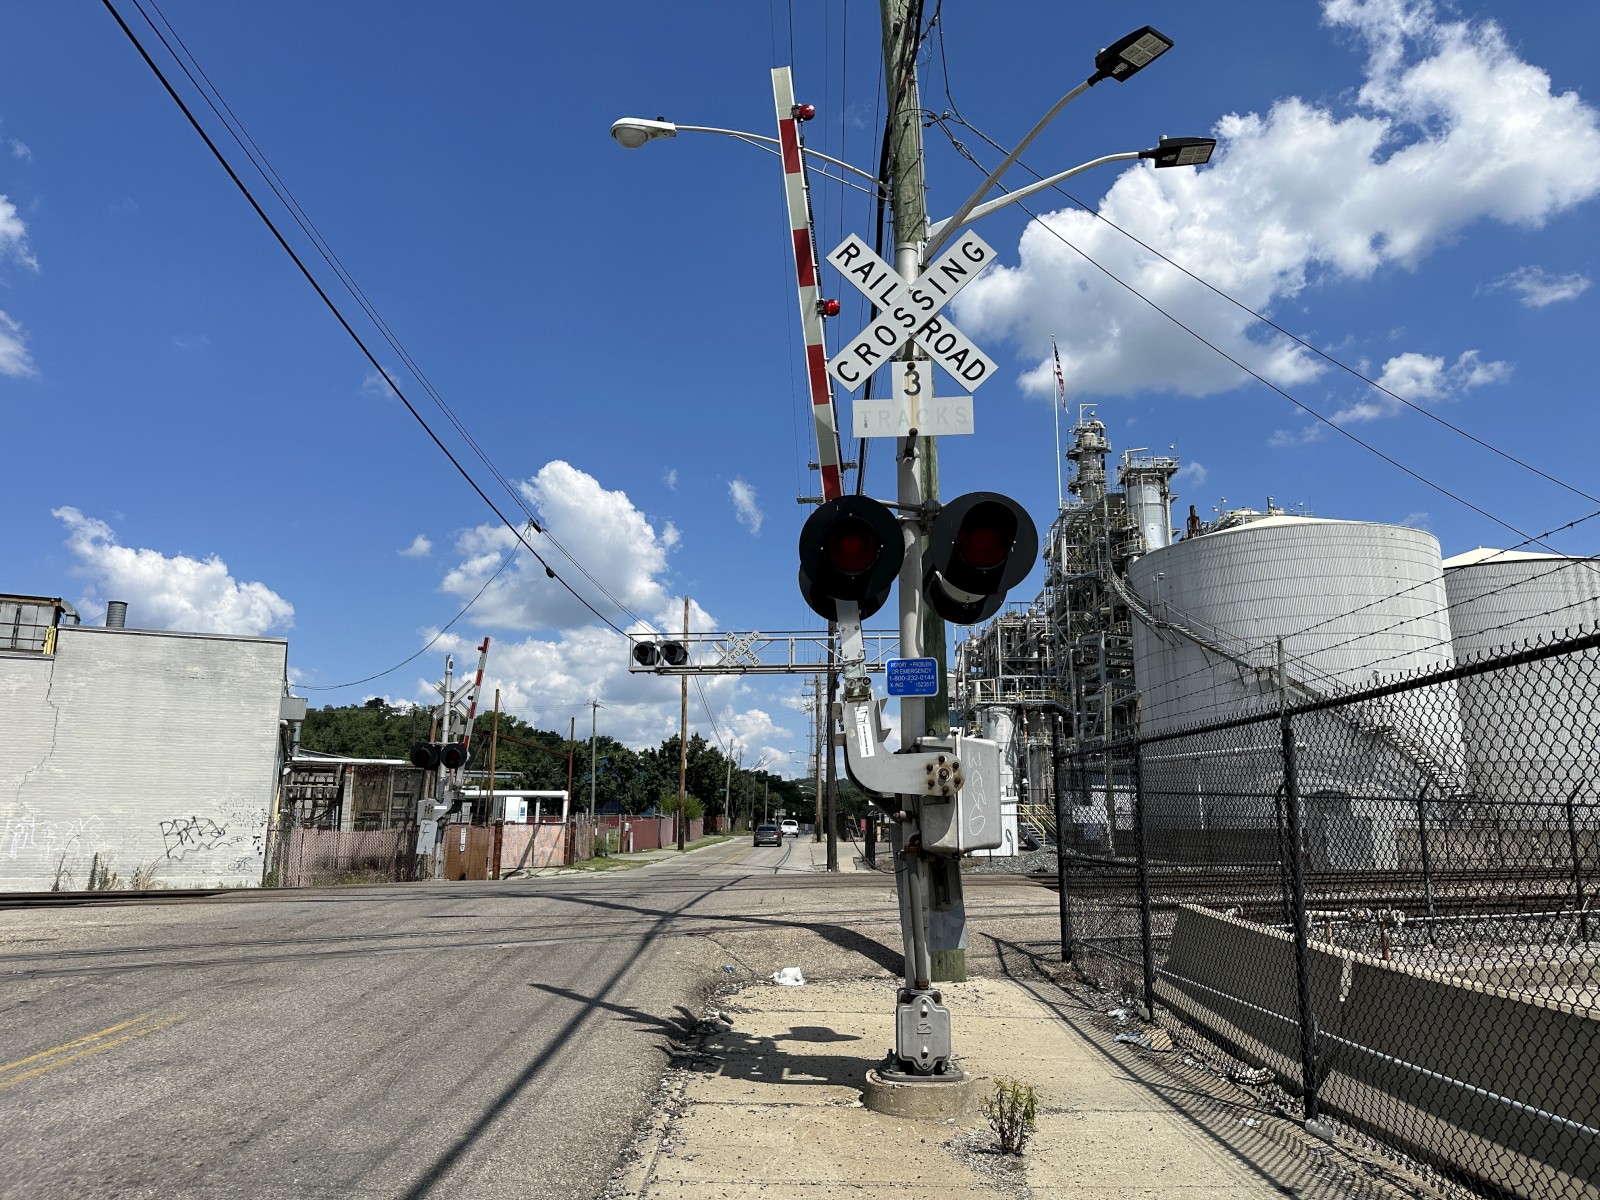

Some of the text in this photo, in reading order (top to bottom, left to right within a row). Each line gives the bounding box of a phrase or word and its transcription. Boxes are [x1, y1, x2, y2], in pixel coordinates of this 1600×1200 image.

[836, 241, 986, 381] RAIL ROAD
[836, 241, 985, 383] CROSSING
[904, 370, 921, 396] 3
[860, 406, 969, 429] TRACKS
[726, 631, 760, 665] RAIL ROAD
[727, 632, 759, 664] CROSSING
